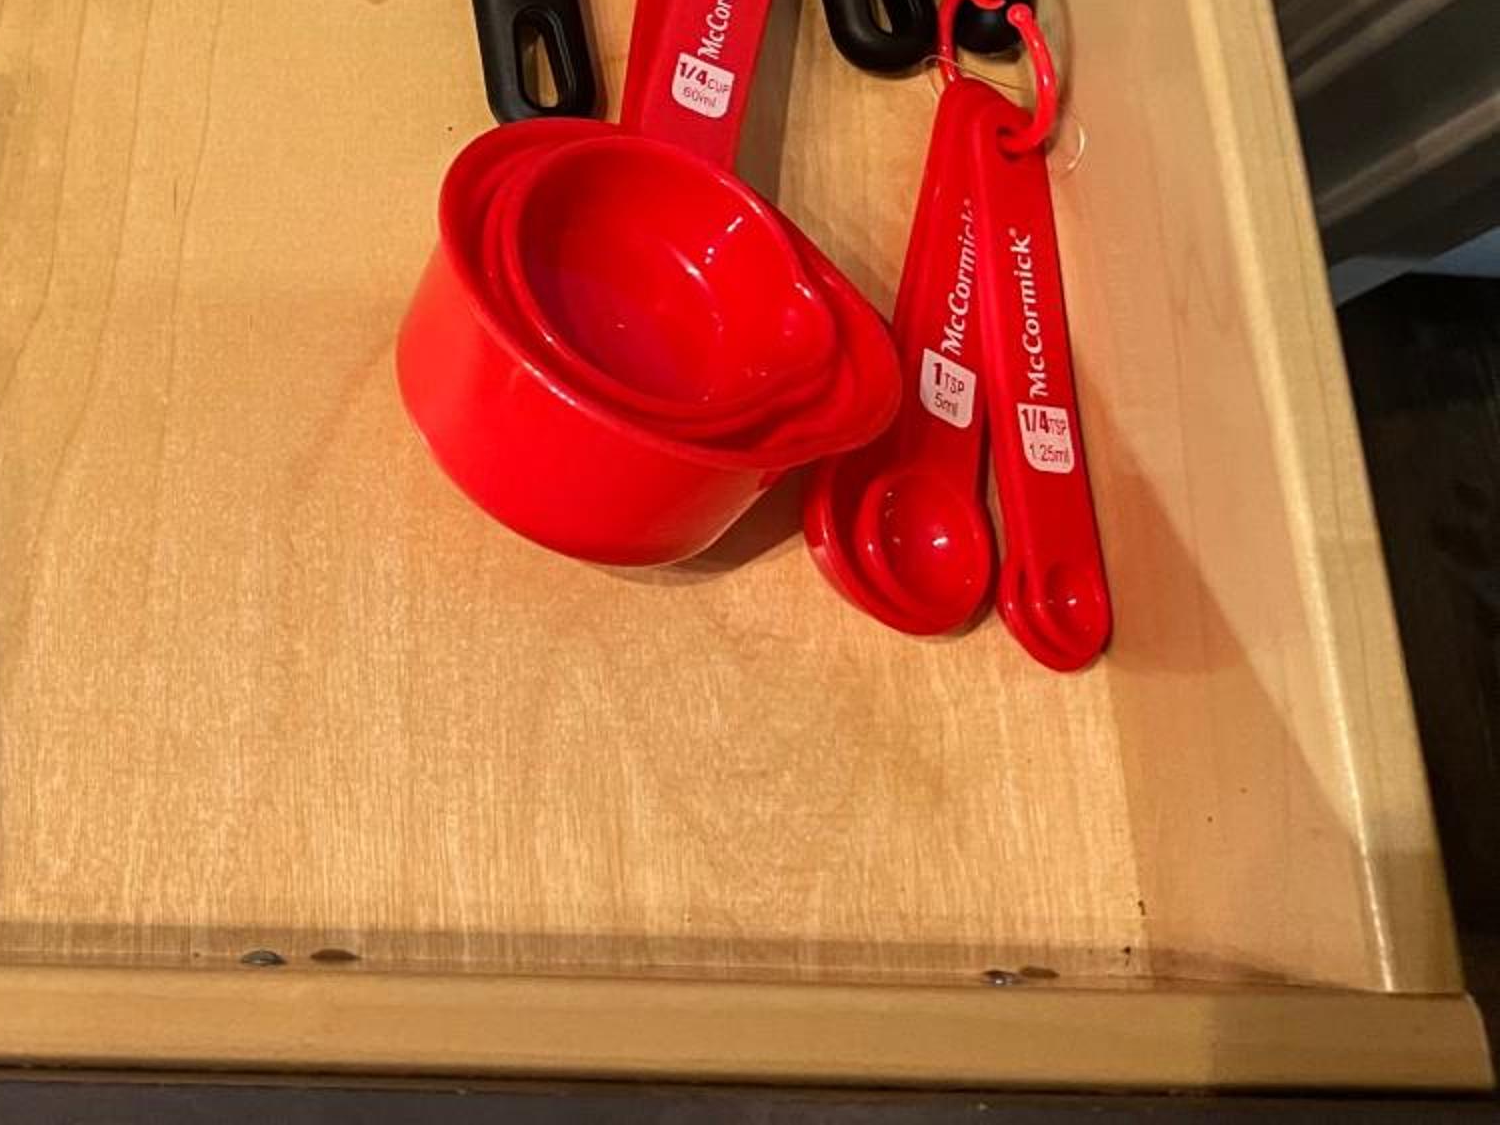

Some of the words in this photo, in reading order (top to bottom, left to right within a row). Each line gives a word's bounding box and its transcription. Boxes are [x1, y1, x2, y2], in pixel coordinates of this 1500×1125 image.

[679, 62, 708, 86] 1/4
[683, 86, 717, 108] 60ml
[1010, 232, 1049, 398] McCormick
[932, 362, 943, 387] 1
[943, 372, 965, 395] TSP
[934, 392, 959, 417] 5ml
[1021, 407, 1049, 434] 1/4
